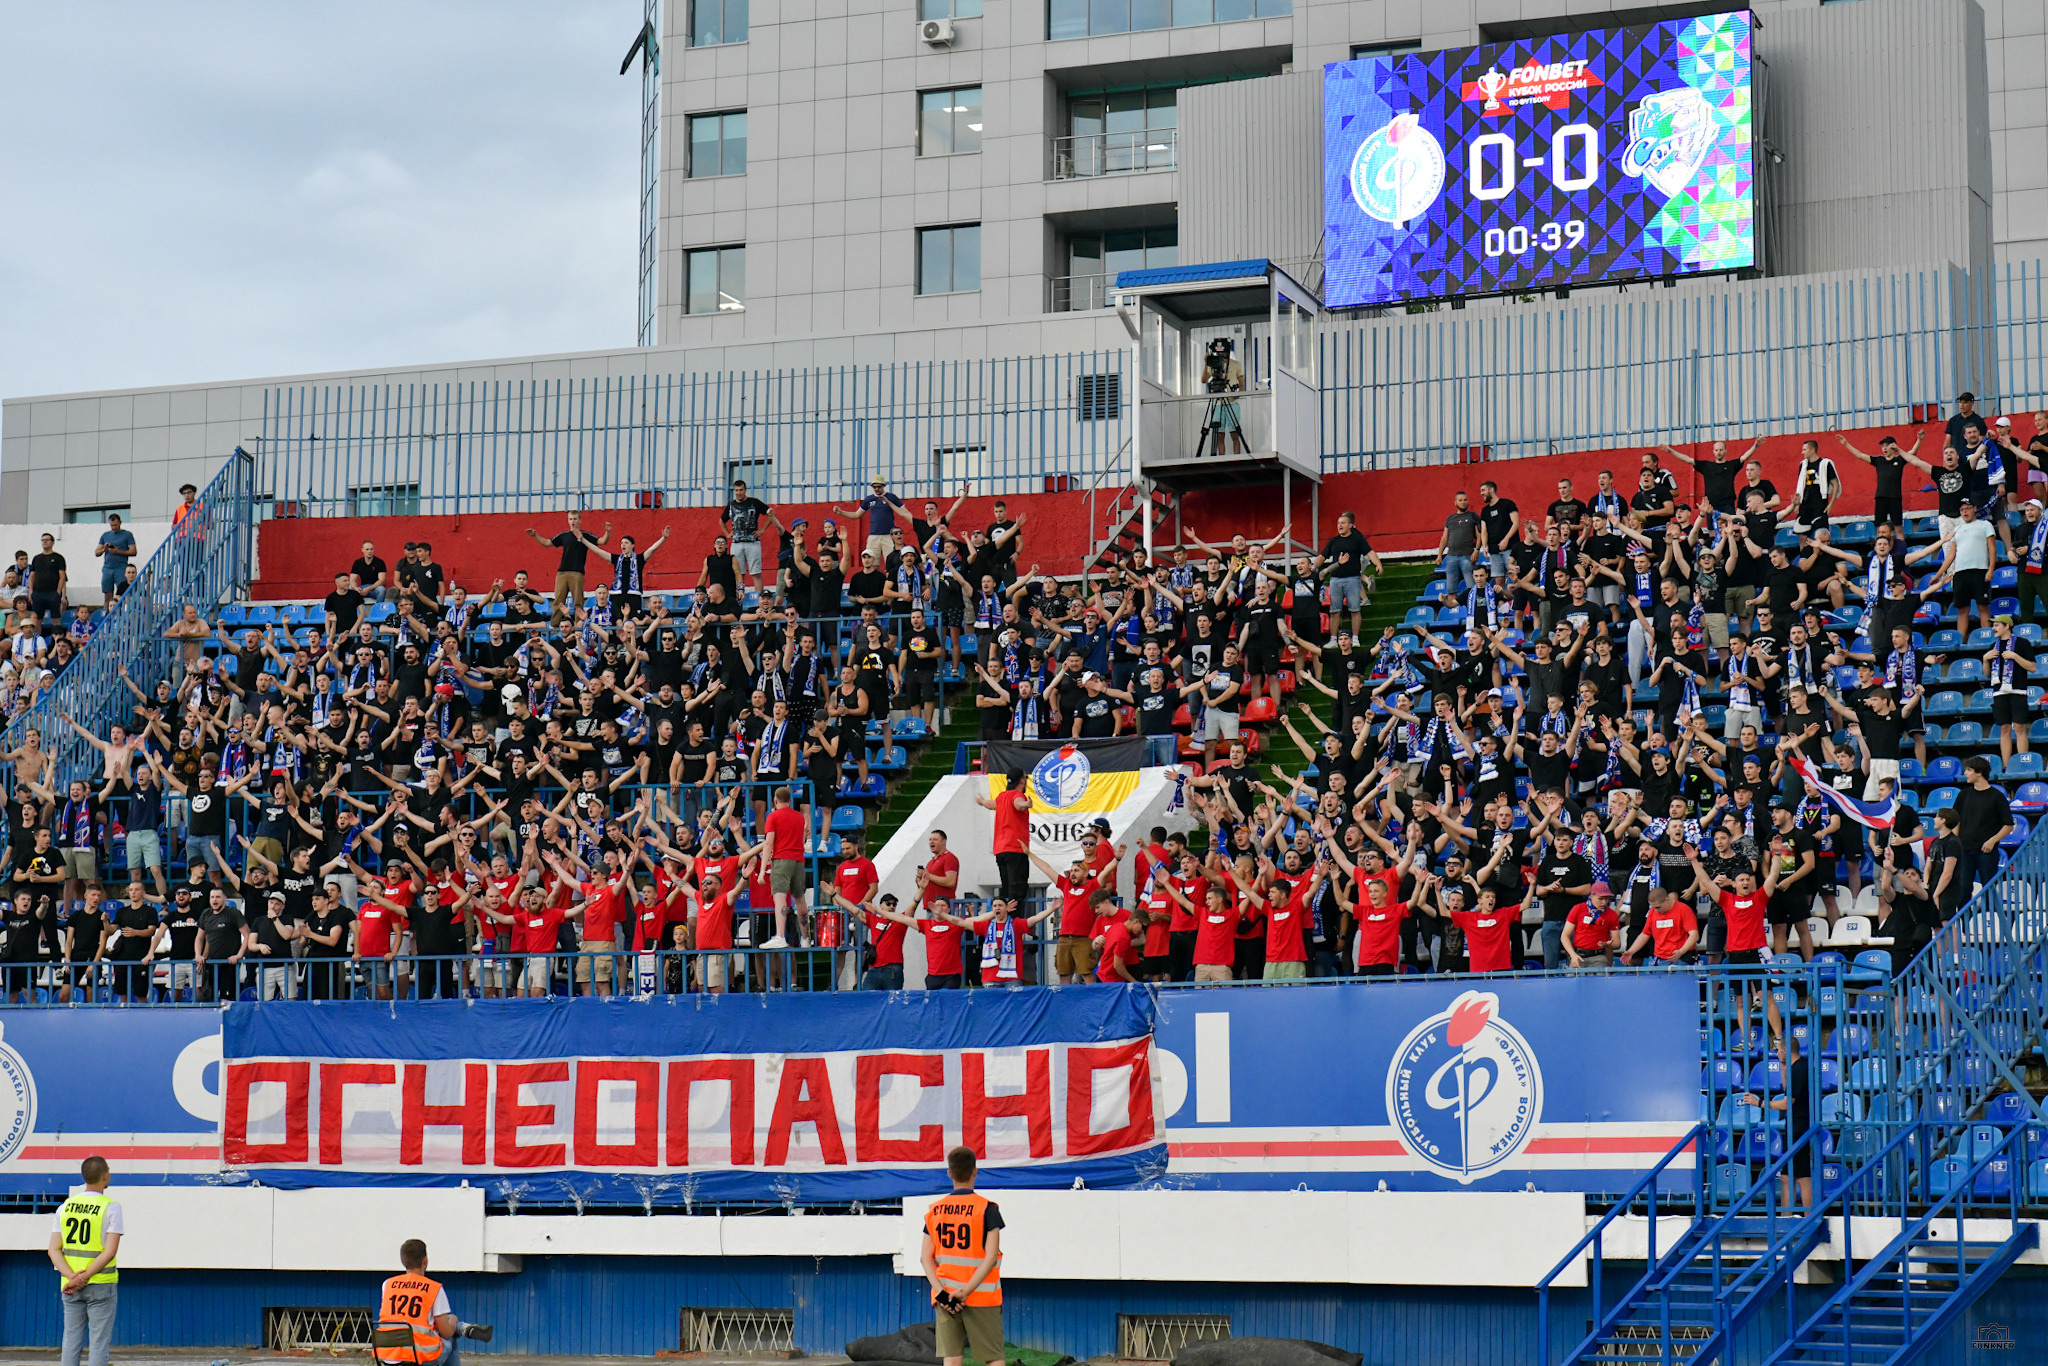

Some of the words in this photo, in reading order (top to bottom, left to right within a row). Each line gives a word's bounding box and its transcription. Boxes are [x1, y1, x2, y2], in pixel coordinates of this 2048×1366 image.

[1508, 59, 1589, 82] FONBET
[1508, 83, 1542, 97] КУБОК
[1544, 78, 1588, 93] РОССИИ
[1484, 220, 1586, 257] 00:39
[1515, 778, 1526, 787] 31
[1847, 923, 1858, 931] 39
[1868, 955, 1880, 963] 40
[1794, 1028, 1806, 1038] 20
[1409, 1032, 1437, 1063] КЛУБ
[1495, 1036, 1526, 1087] «ФАКЕЛ»
[224, 1039, 1155, 1167] ОГНЕОПАСНО
[2009, 1098, 2015, 1107] 1
[1398, 1069, 1440, 1156] ФУТБОЛЬНЫЙ
[1490, 1096, 1528, 1155] ВОРОНЕЖ
[1981, 1132, 1987, 1141] 1
[1824, 1169, 1837, 1179] 47
[65, 1201, 101, 1217] СТЮАРД
[933, 1204, 975, 1217] СТЮАРД
[65, 1217, 92, 1245] 20
[936, 1222, 971, 1250] 159
[391, 1279, 431, 1293] СТЮАРД
[388, 1293, 424, 1318] 126
